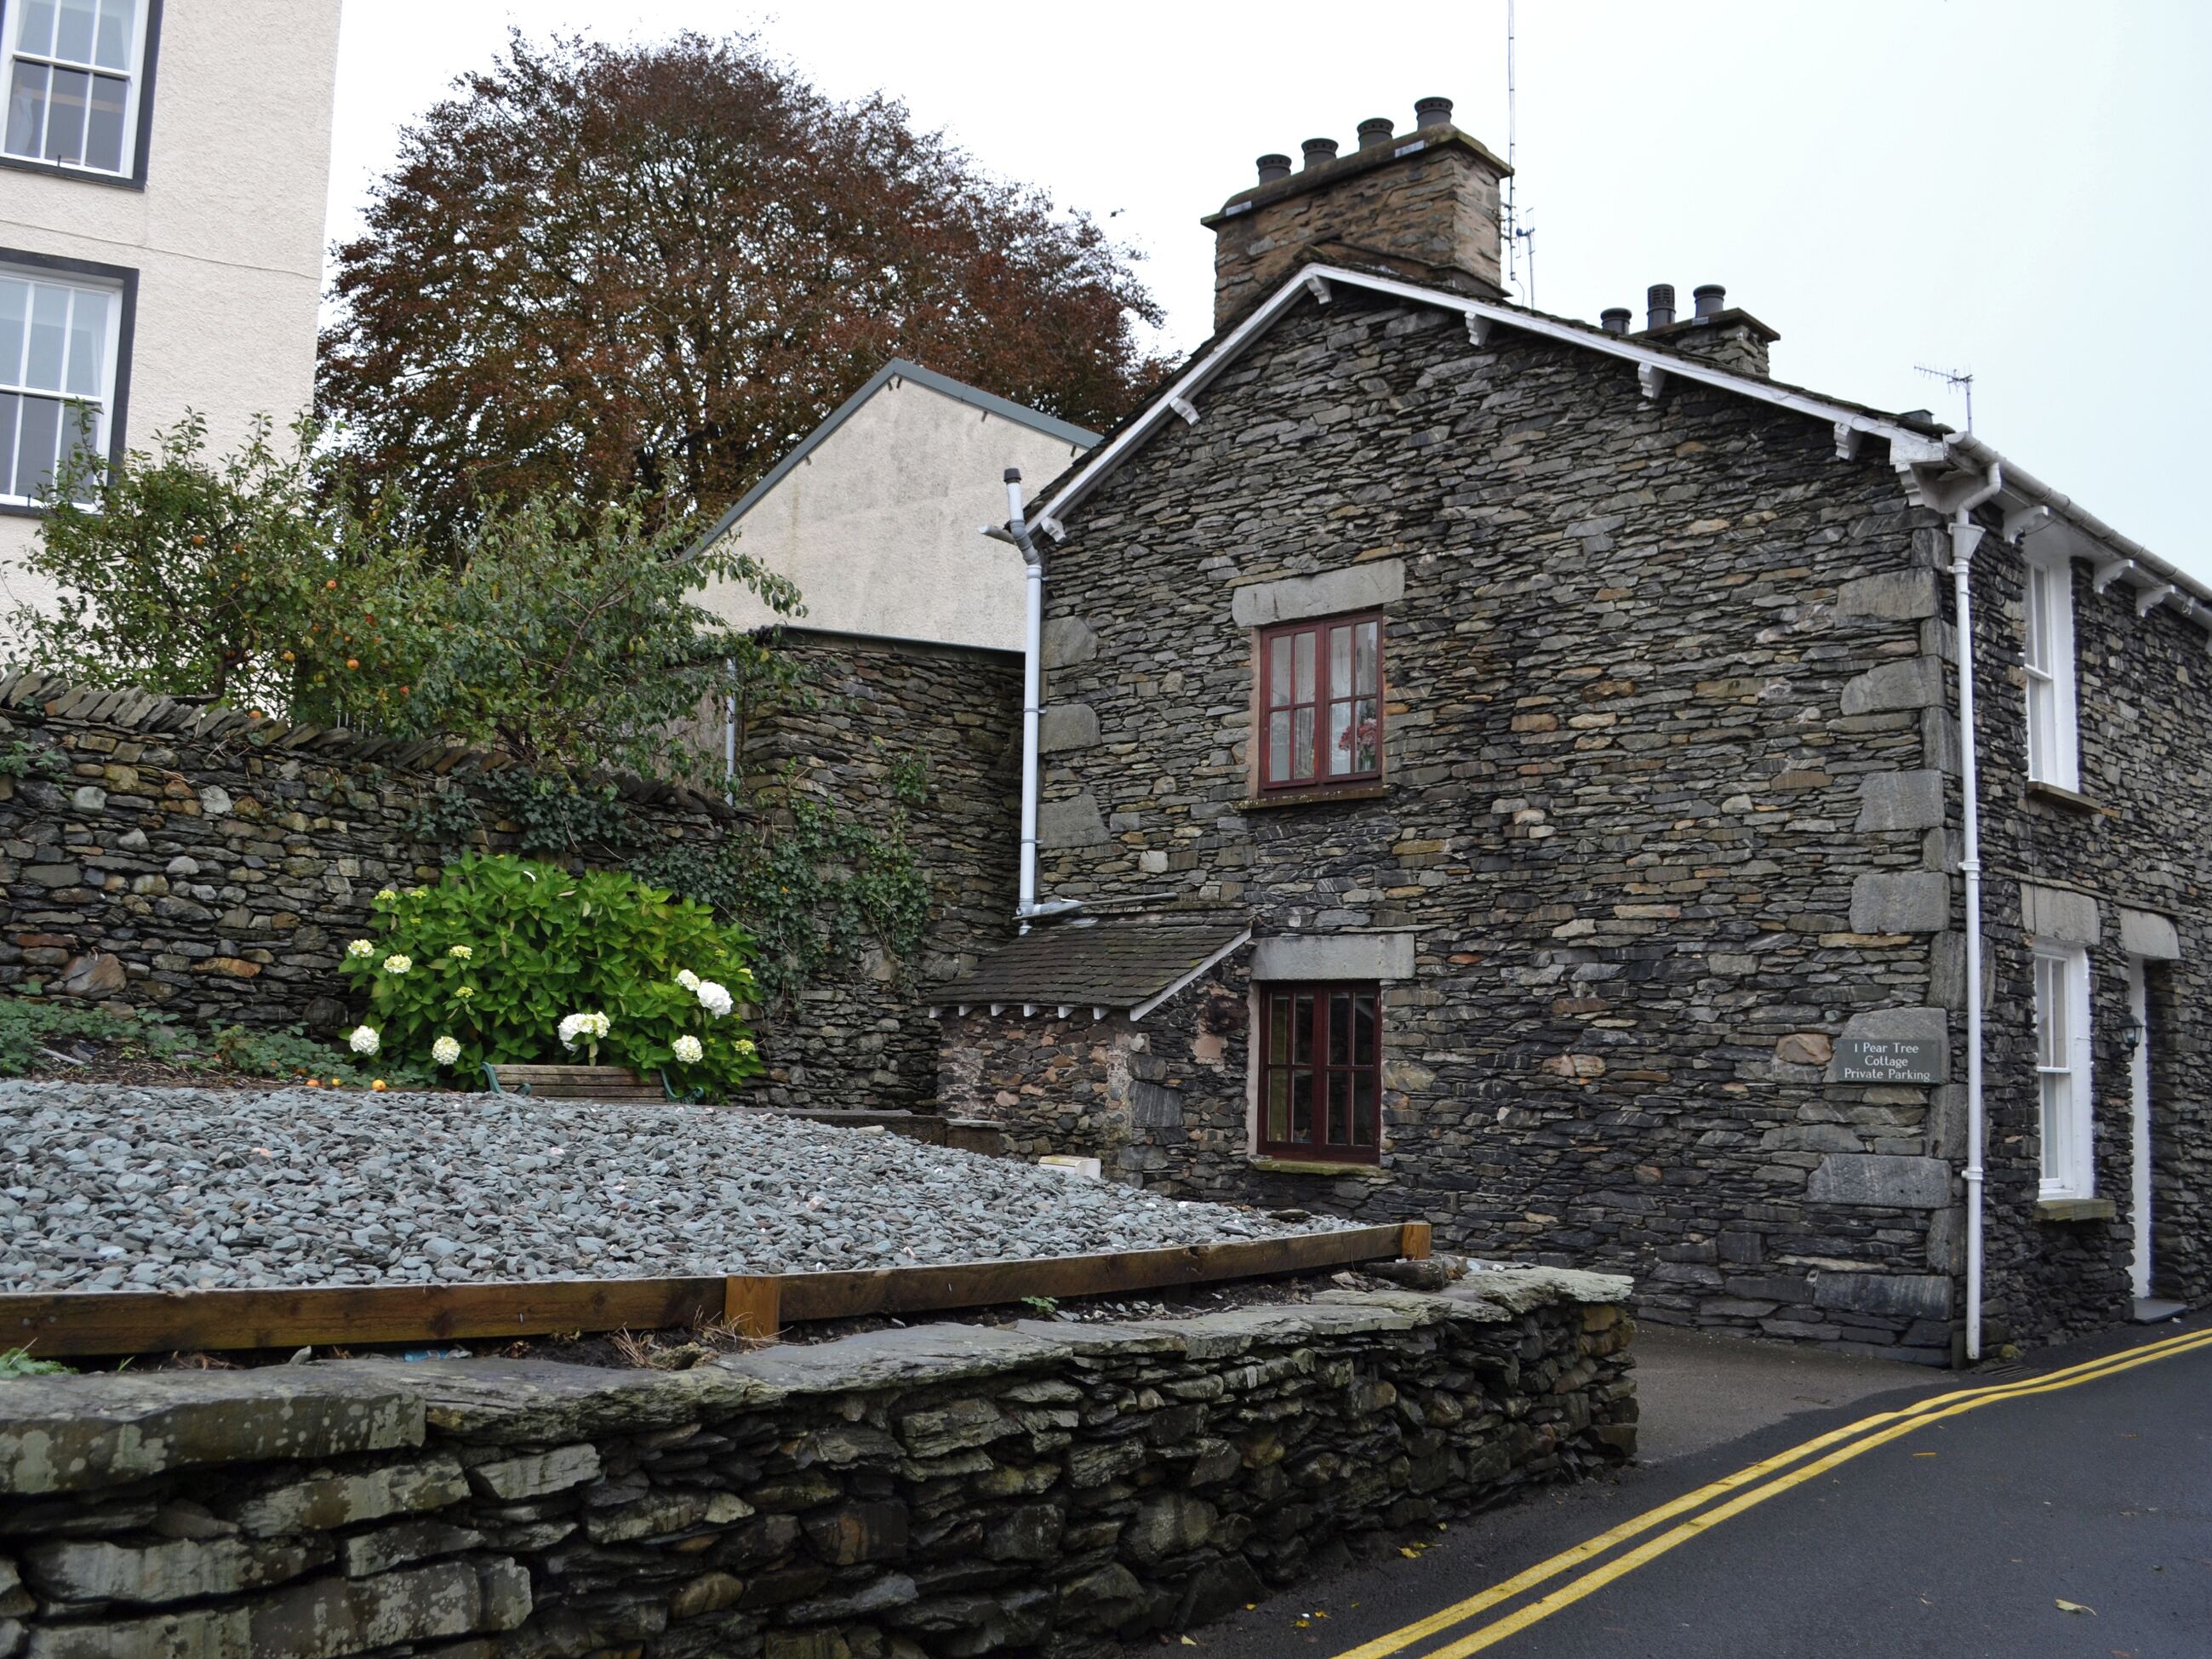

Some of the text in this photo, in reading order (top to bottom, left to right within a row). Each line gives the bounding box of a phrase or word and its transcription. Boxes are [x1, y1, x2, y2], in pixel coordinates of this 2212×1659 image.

[1863, 1042, 1888, 1053] Pear
[1893, 1043, 1919, 1054] Tree
[1865, 1055, 1908, 1068] Cottage
[1844, 1068, 1930, 1082] Private Parking
